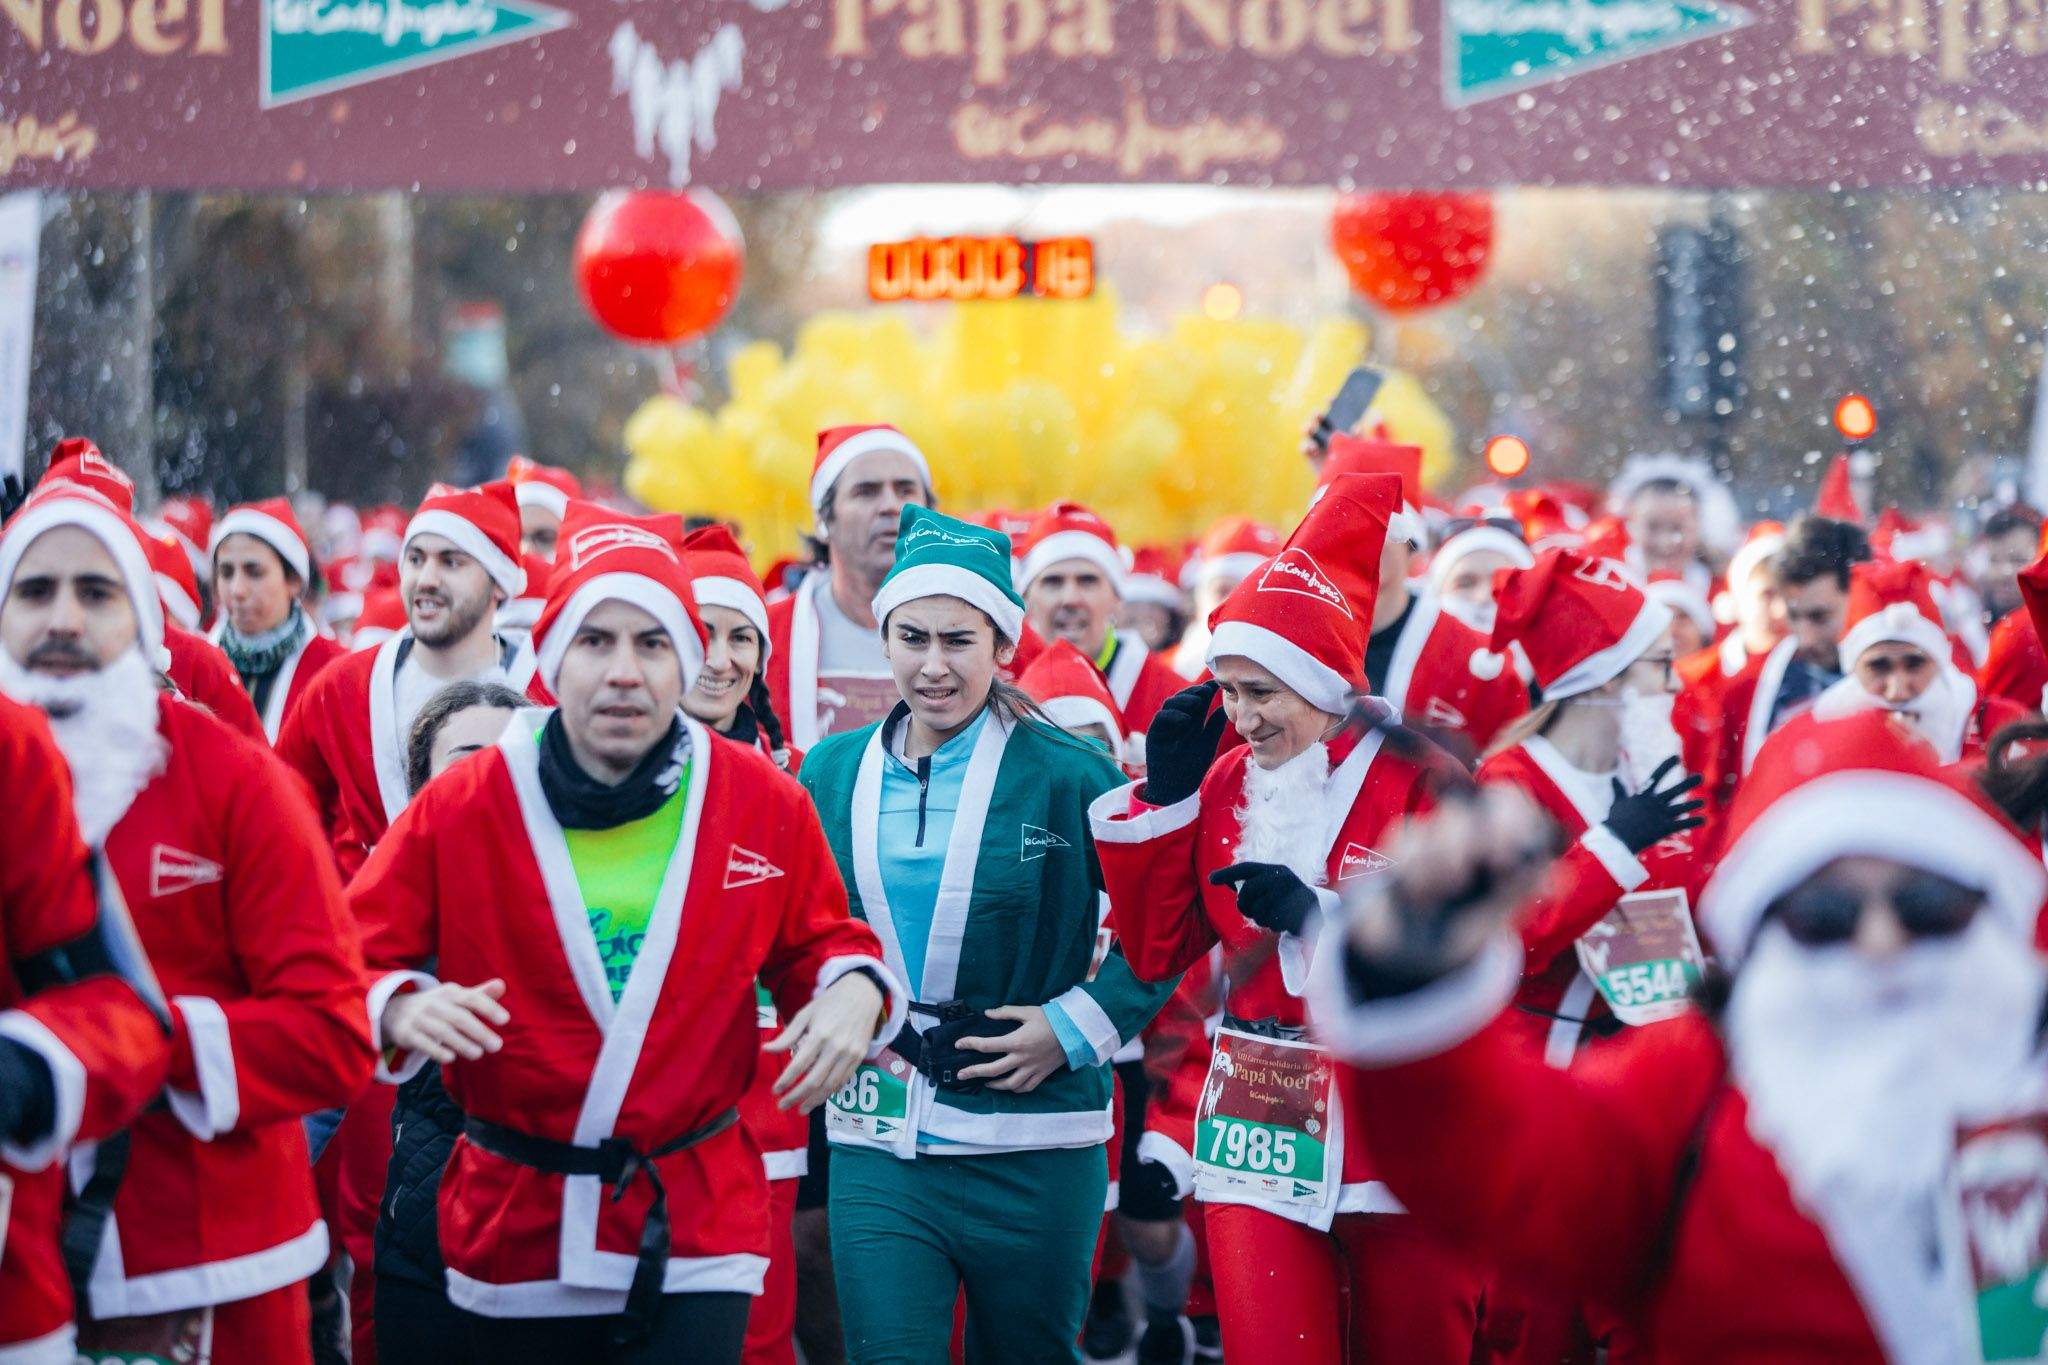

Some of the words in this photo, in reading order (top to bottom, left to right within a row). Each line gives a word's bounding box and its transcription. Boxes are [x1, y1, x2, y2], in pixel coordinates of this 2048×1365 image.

[1608, 961, 1688, 1006] 5544
[1232, 1062, 1266, 1087] Papá
[1270, 1070, 1311, 1090] Noel
[1209, 1118, 1297, 1174] 7985
